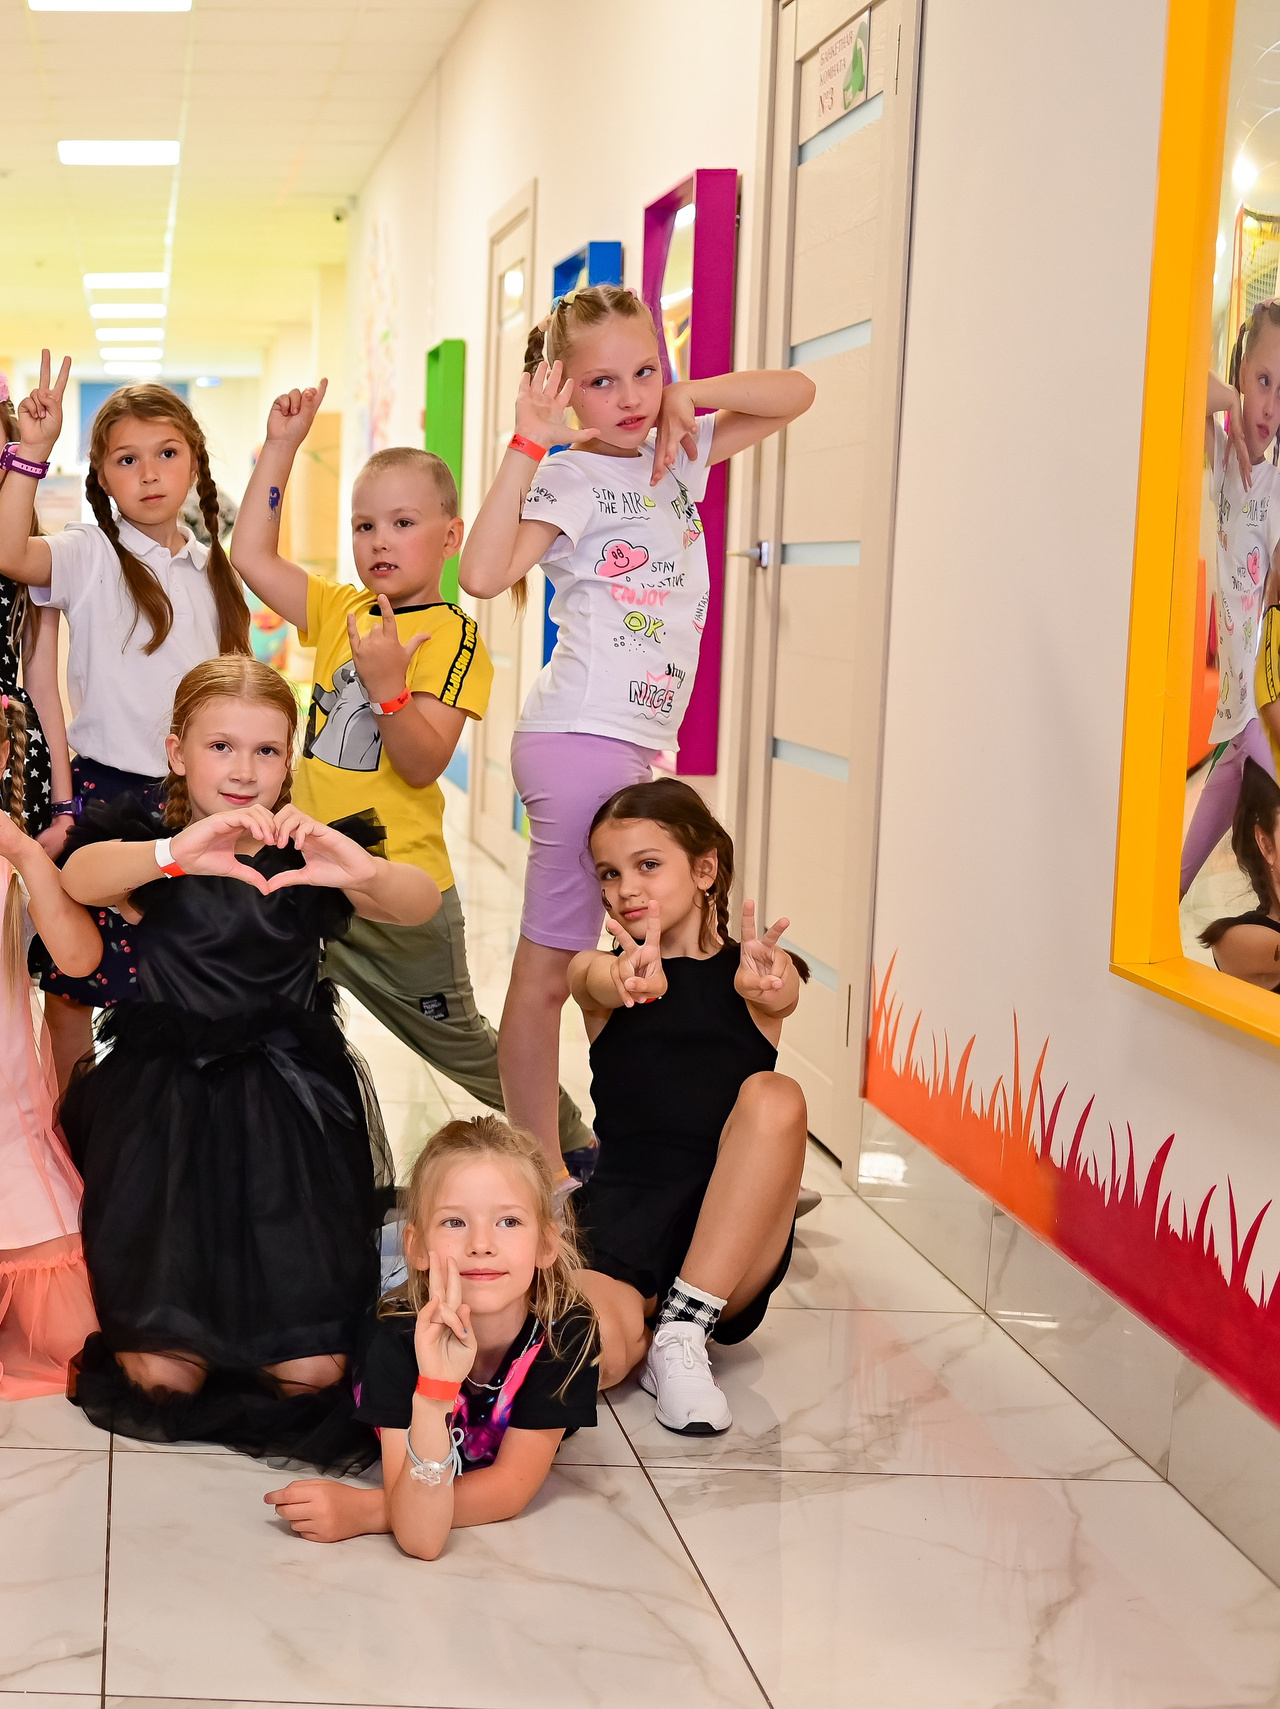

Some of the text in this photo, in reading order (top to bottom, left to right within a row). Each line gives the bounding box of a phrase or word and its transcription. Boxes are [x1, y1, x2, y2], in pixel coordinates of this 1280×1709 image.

[533, 486, 558, 505] NEVER
[598, 491, 648, 514] THE AIR
[651, 561, 675, 574] STAY
[611, 584, 671, 607] ENJOY
[623, 611, 664, 644] OK
[629, 681, 675, 713] NICE
